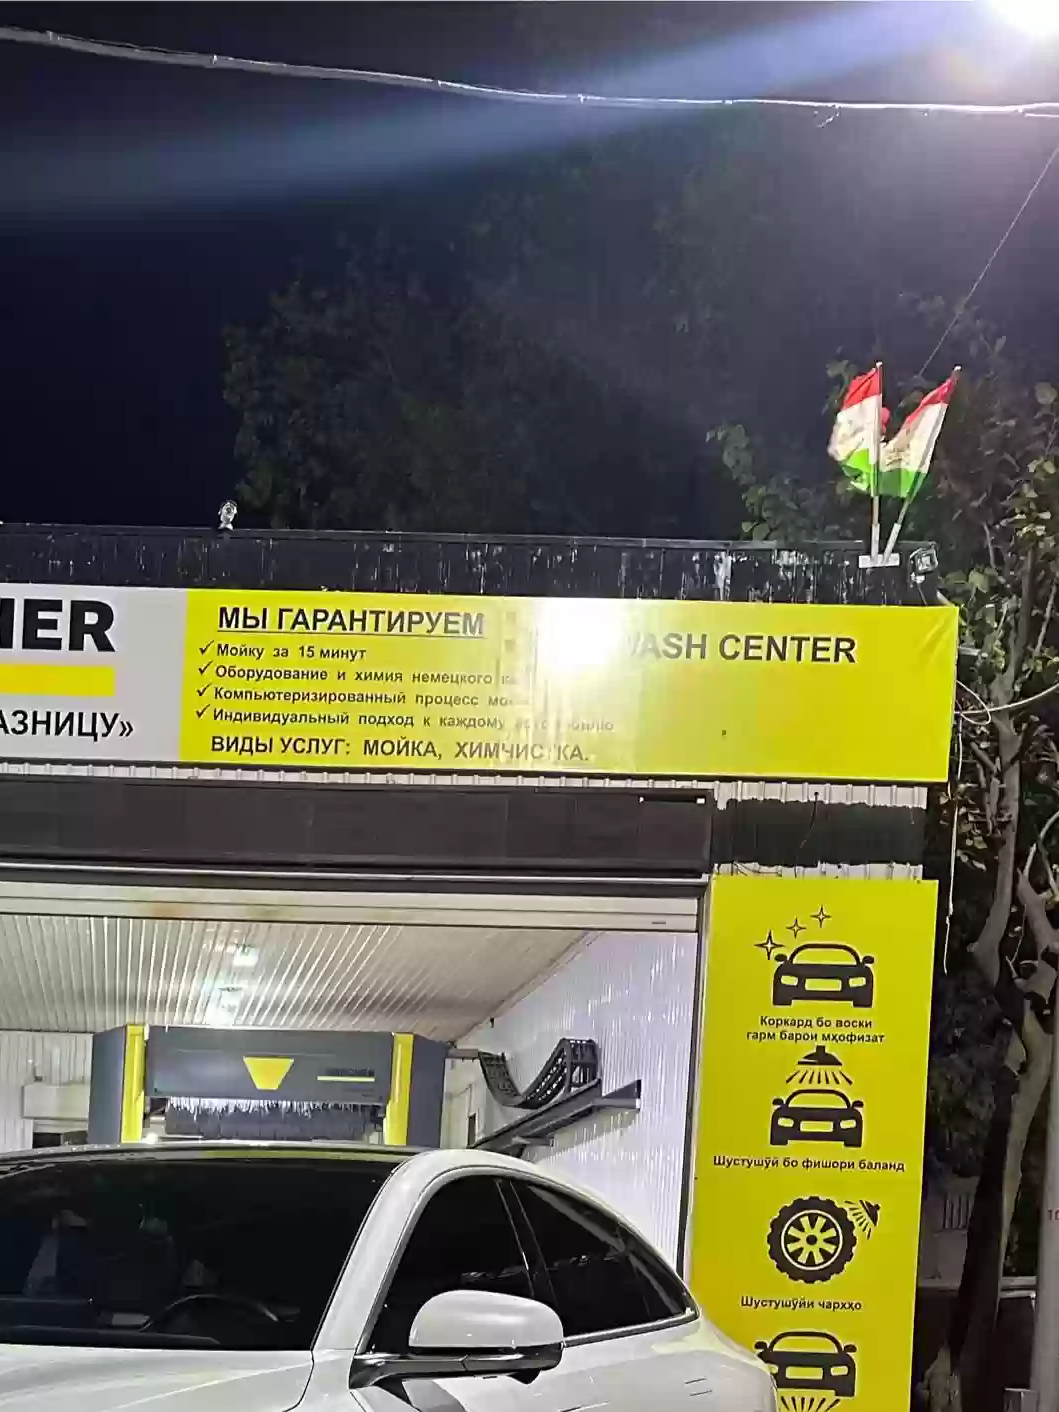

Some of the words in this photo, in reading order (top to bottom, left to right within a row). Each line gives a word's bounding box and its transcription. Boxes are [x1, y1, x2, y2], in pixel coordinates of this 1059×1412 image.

[218, 606, 267, 630] МЫ
[277, 607, 484, 635] ГАРАНТИРУЕМ
[216, 643, 264, 660] Мойку
[273, 648, 289, 657] за
[299, 645, 315, 658] 15
[319, 648, 367, 662] минут
[719, 633, 856, 664] CENTER
[215, 665, 328, 682] Оборудование
[337, 671, 347, 681] и
[355, 671, 403, 682] химия
[411, 672, 493, 686] немецкого
[214, 686, 406, 704] Компьютеризированный
[415, 693, 479, 708] процесс
[213, 707, 350, 726] Индивидуальный
[358, 714, 415, 727] подход
[423, 716, 431, 727] к
[439, 716, 506, 731] каждому
[211, 736, 274, 756] ВИДЫ
[280, 737, 351, 756] УСЛУГ:
[363, 736, 443, 761] МОЙКА,
[760, 1016, 814, 1029] Коркард
[816, 1017, 832, 1028] бо
[835, 1020, 873, 1029] воски
[746, 1031, 776, 1043] гарм
[779, 1030, 818, 1043] барои
[783, 1156, 799, 1168] бо
[802, 1157, 854, 1171] фишори
[858, 1159, 904, 1172] баланд
